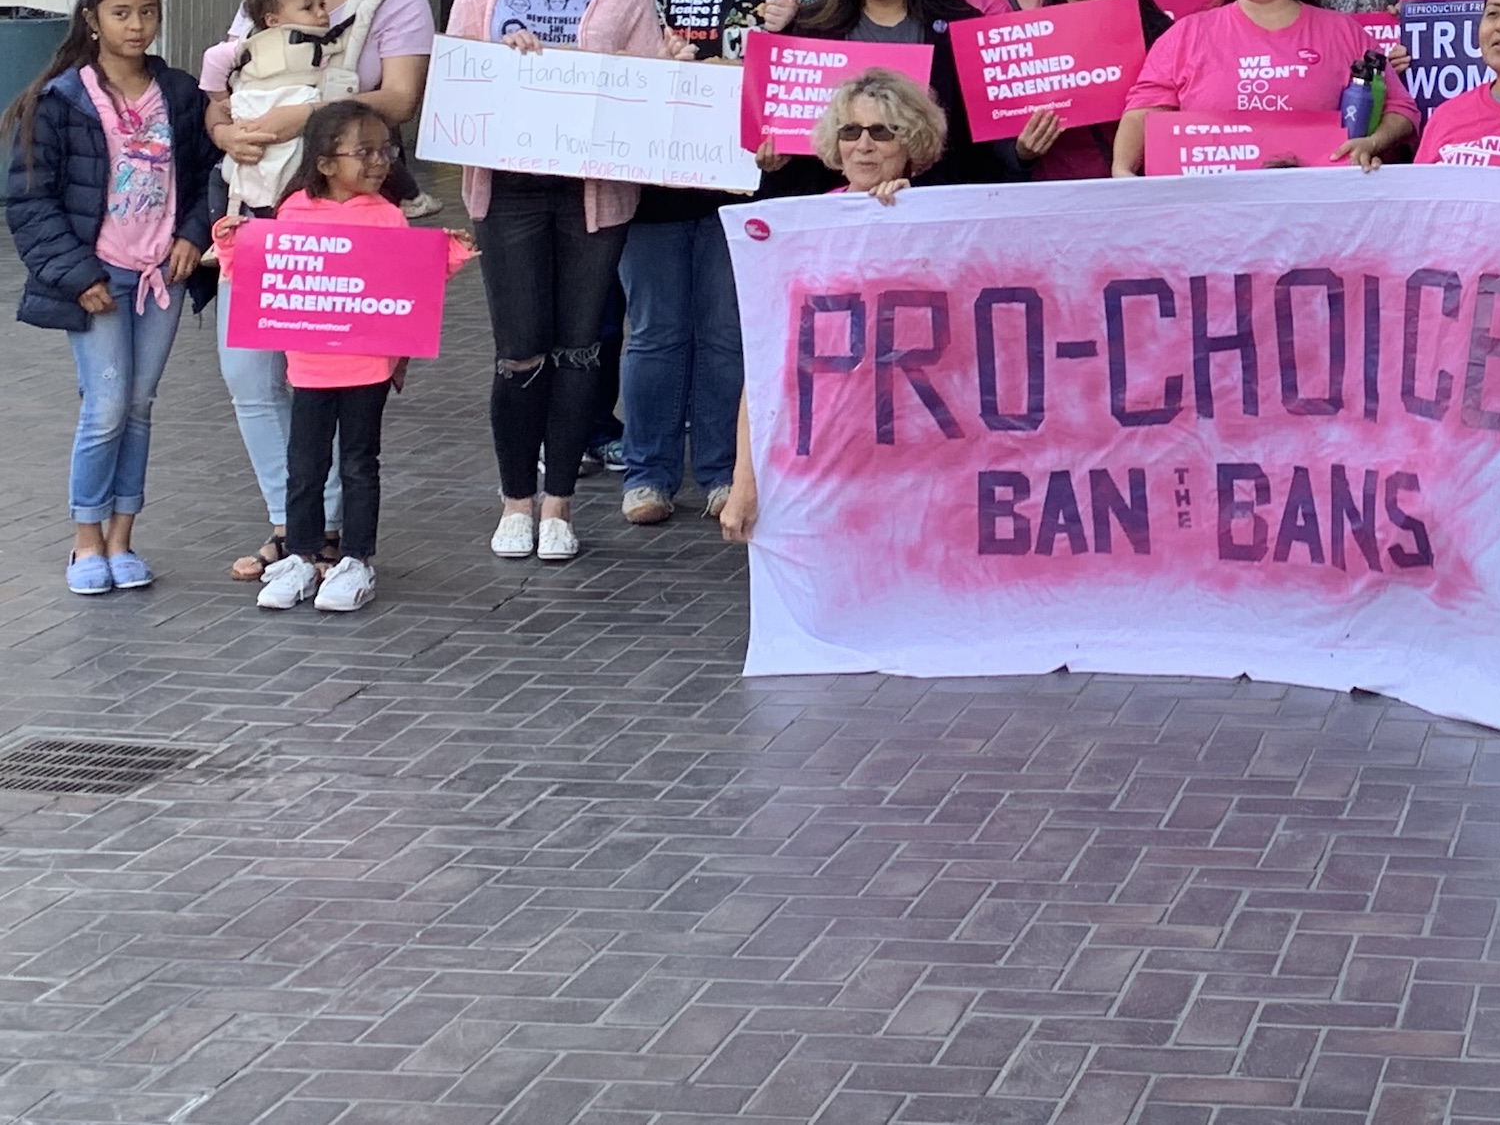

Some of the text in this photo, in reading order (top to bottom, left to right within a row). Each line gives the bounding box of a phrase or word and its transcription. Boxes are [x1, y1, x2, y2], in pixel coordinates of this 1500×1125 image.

[1407, 4, 1466, 14] REPRODUCTIVE
[674, 16, 709, 27] Jobs
[977, 20, 1054, 46] I STAND
[1405, 20, 1482, 60] TRU
[771, 47, 848, 68] I STAND
[980, 42, 1034, 64] WITH
[1239, 55, 1271, 67] WE
[438, 45, 498, 79] The
[518, 53, 648, 89] Handmaid's
[667, 70, 716, 98] Tale
[769, 65, 822, 83] WITH
[983, 54, 1075, 83] PLANNED
[1238, 65, 1308, 78] WON'T
[986, 66, 1122, 101] PARENTHOOD
[1237, 79, 1269, 94] GO
[1405, 65, 1497, 100] WOM
[766, 83, 835, 103] PLANN
[1237, 95, 1293, 111] BACK.
[433, 112, 495, 147] NOT
[517, 132, 532, 148] a
[1180, 145, 1260, 163] I STAND
[265, 234, 352, 253] I STAND
[265, 254, 324, 272] WITH
[262, 273, 365, 293] PLANNED
[260, 293, 413, 315] PARENTHOOD
[268, 319, 301, 330] Planned
[977, 462, 1434, 573] BAN THE BANS
